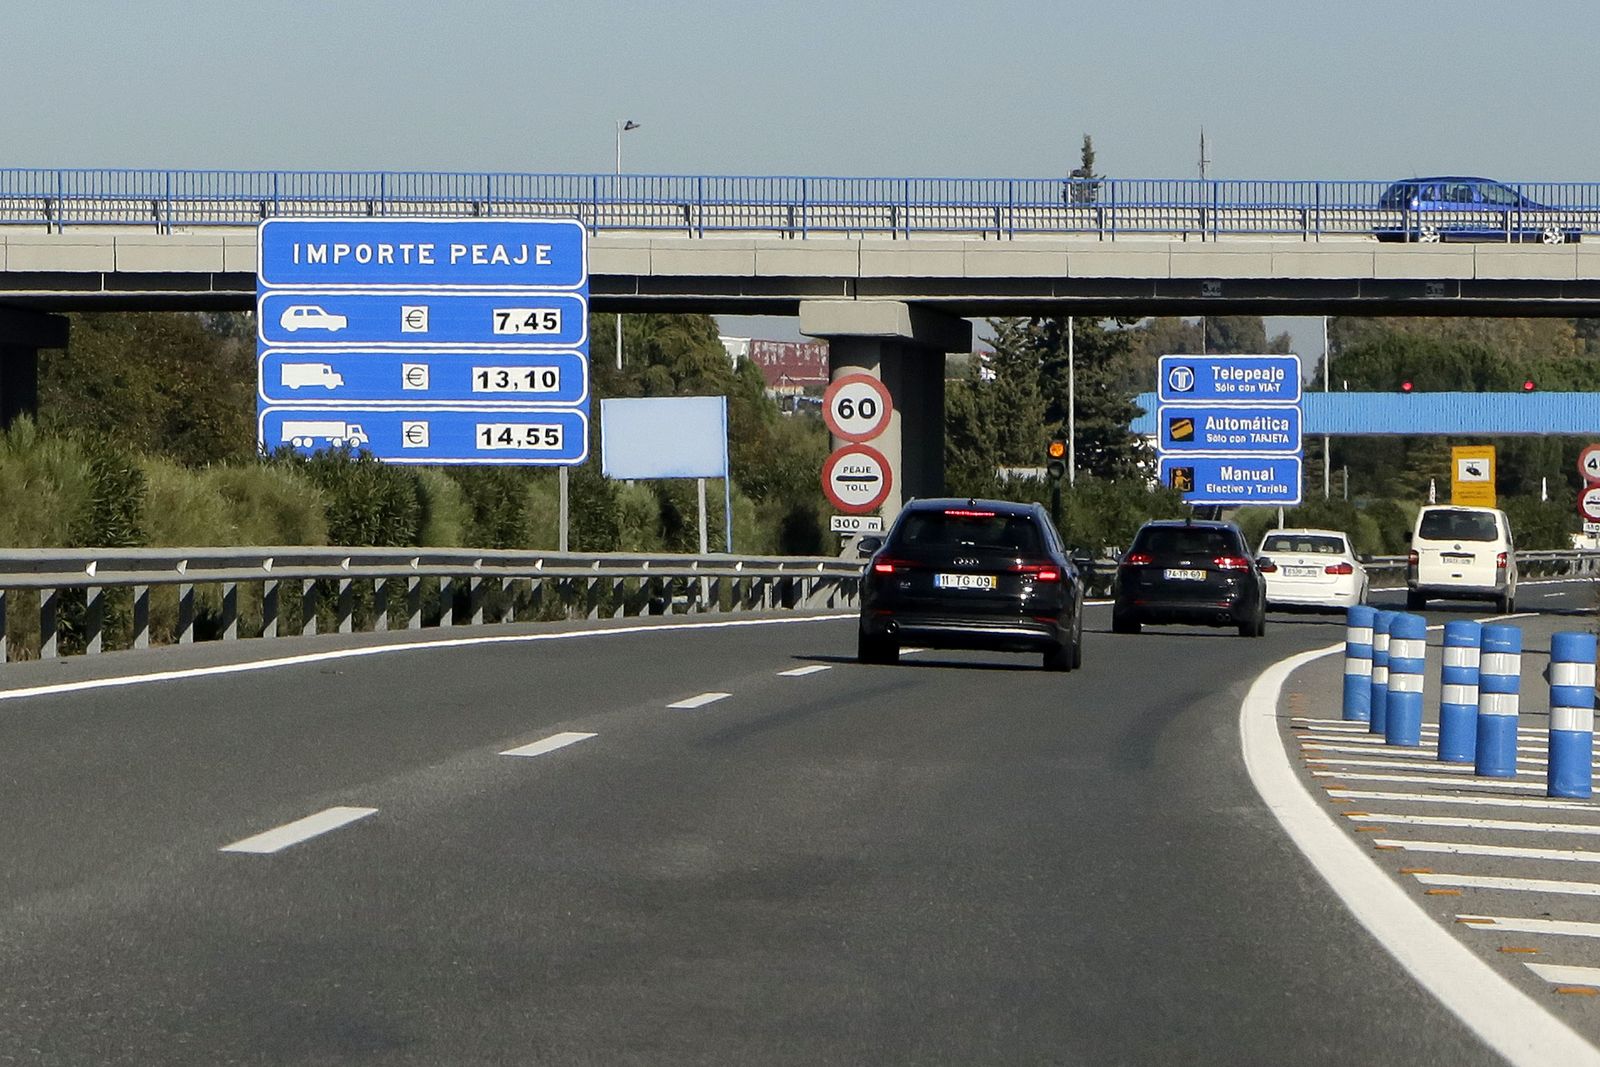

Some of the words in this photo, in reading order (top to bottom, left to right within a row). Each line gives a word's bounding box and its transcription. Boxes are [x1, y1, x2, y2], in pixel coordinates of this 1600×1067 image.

[292, 243, 435, 265] IMPORTE
[450, 243, 553, 266] PEAJE
[405, 309, 426, 330] €
[495, 311, 558, 334] 7,45
[405, 366, 426, 388] €
[476, 370, 557, 391] 13,10
[1211, 365, 1285, 383] Telepeaje
[1238, 384, 1256, 393] con
[837, 398, 877, 419] 60
[1205, 415, 1290, 431] Automática
[405, 424, 426, 446] €
[480, 427, 560, 448] 14,55
[1229, 434, 1247, 443] con
[1250, 433, 1290, 444] TARJETA
[842, 465, 872, 474] PEAJE
[1220, 465, 1275, 481] Manual
[845, 483, 870, 492] TOLL
[1206, 483, 1245, 494] Efectivo
[1247, 485, 1253, 495] y
[834, 518, 861, 529] 300
[868, 521, 879, 530] m
